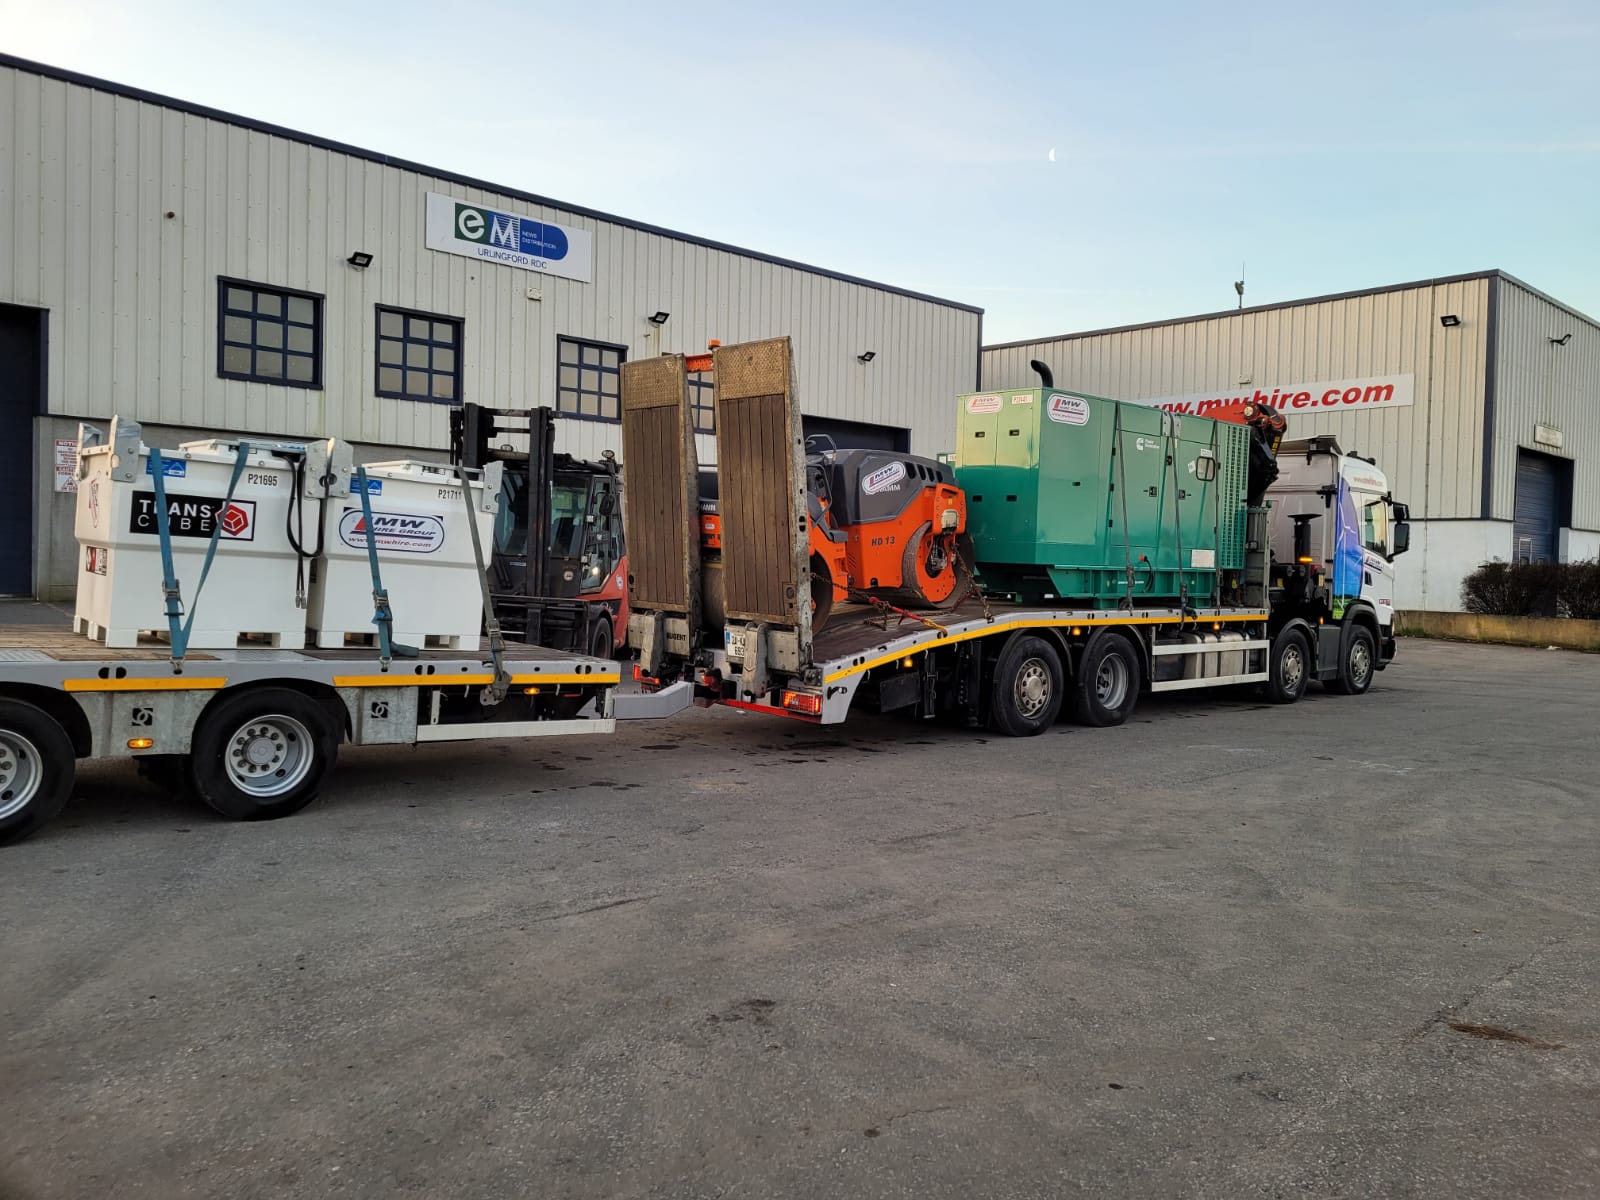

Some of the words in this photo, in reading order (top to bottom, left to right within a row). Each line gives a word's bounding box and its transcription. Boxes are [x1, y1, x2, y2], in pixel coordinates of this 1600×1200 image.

[477, 247, 529, 265] URLINGFORD
[531, 259, 548, 269] RDC
[1061, 399, 1082, 408] MW
[247, 473, 278, 487] P21695
[438, 489, 462, 501] P21711
[137, 514, 211, 532] CBE
[374, 517, 426, 529] MW
[399, 529, 437, 537] GROUP
[348, 536, 432, 548] wwwmwhire.com
[871, 537, 883, 547] HD
[885, 535, 896, 545] 13
